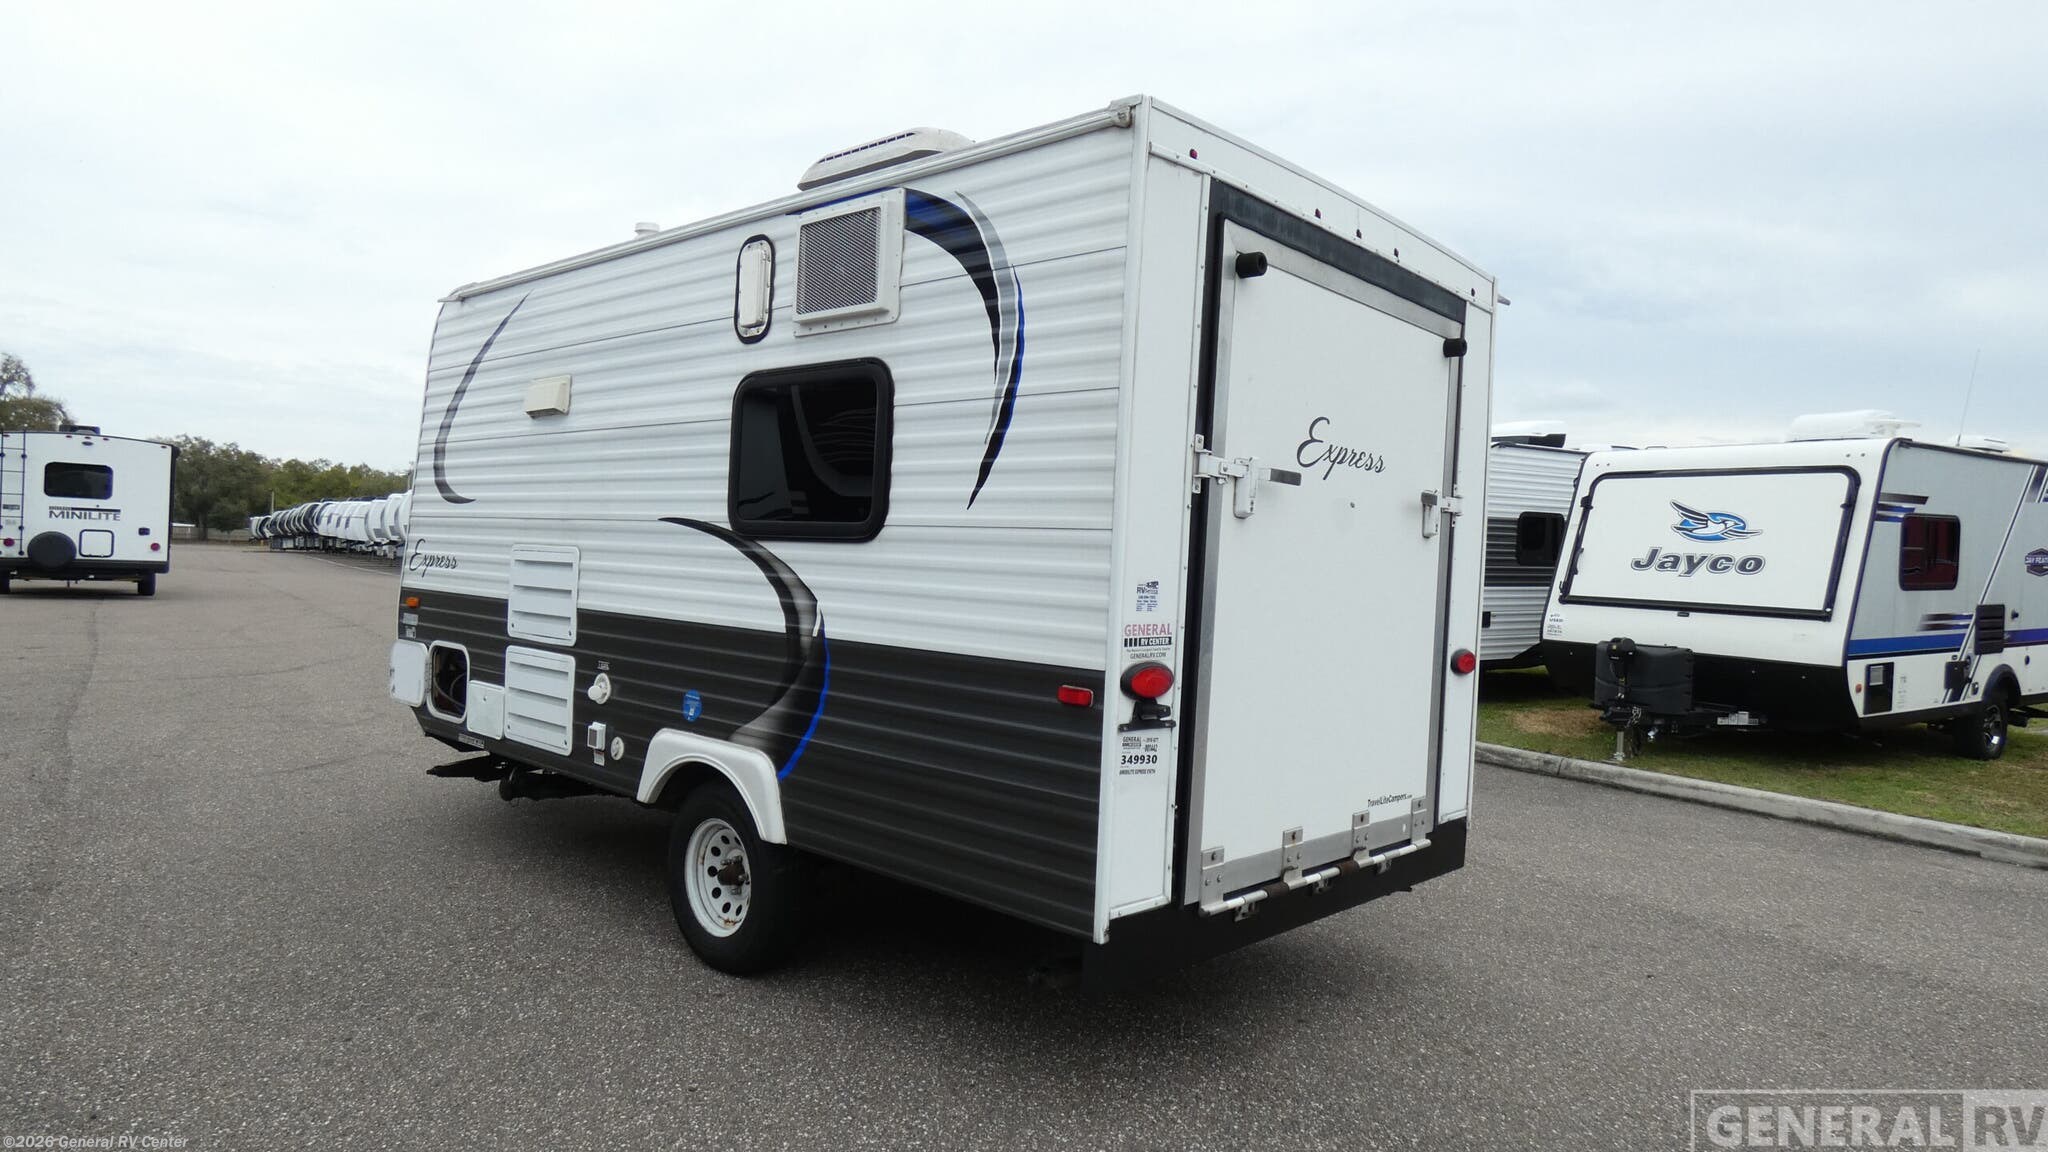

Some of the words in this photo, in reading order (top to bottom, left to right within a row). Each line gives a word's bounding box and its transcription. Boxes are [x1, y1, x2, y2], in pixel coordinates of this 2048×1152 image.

[1296, 416, 1386, 481] Express
[48, 511, 121, 521] MINILITE
[409, 538, 459, 578] Express
[1630, 547, 1766, 577] Jayco
[1124, 623, 1172, 637] GENERAL
[1121, 754, 1157, 765] 349930
